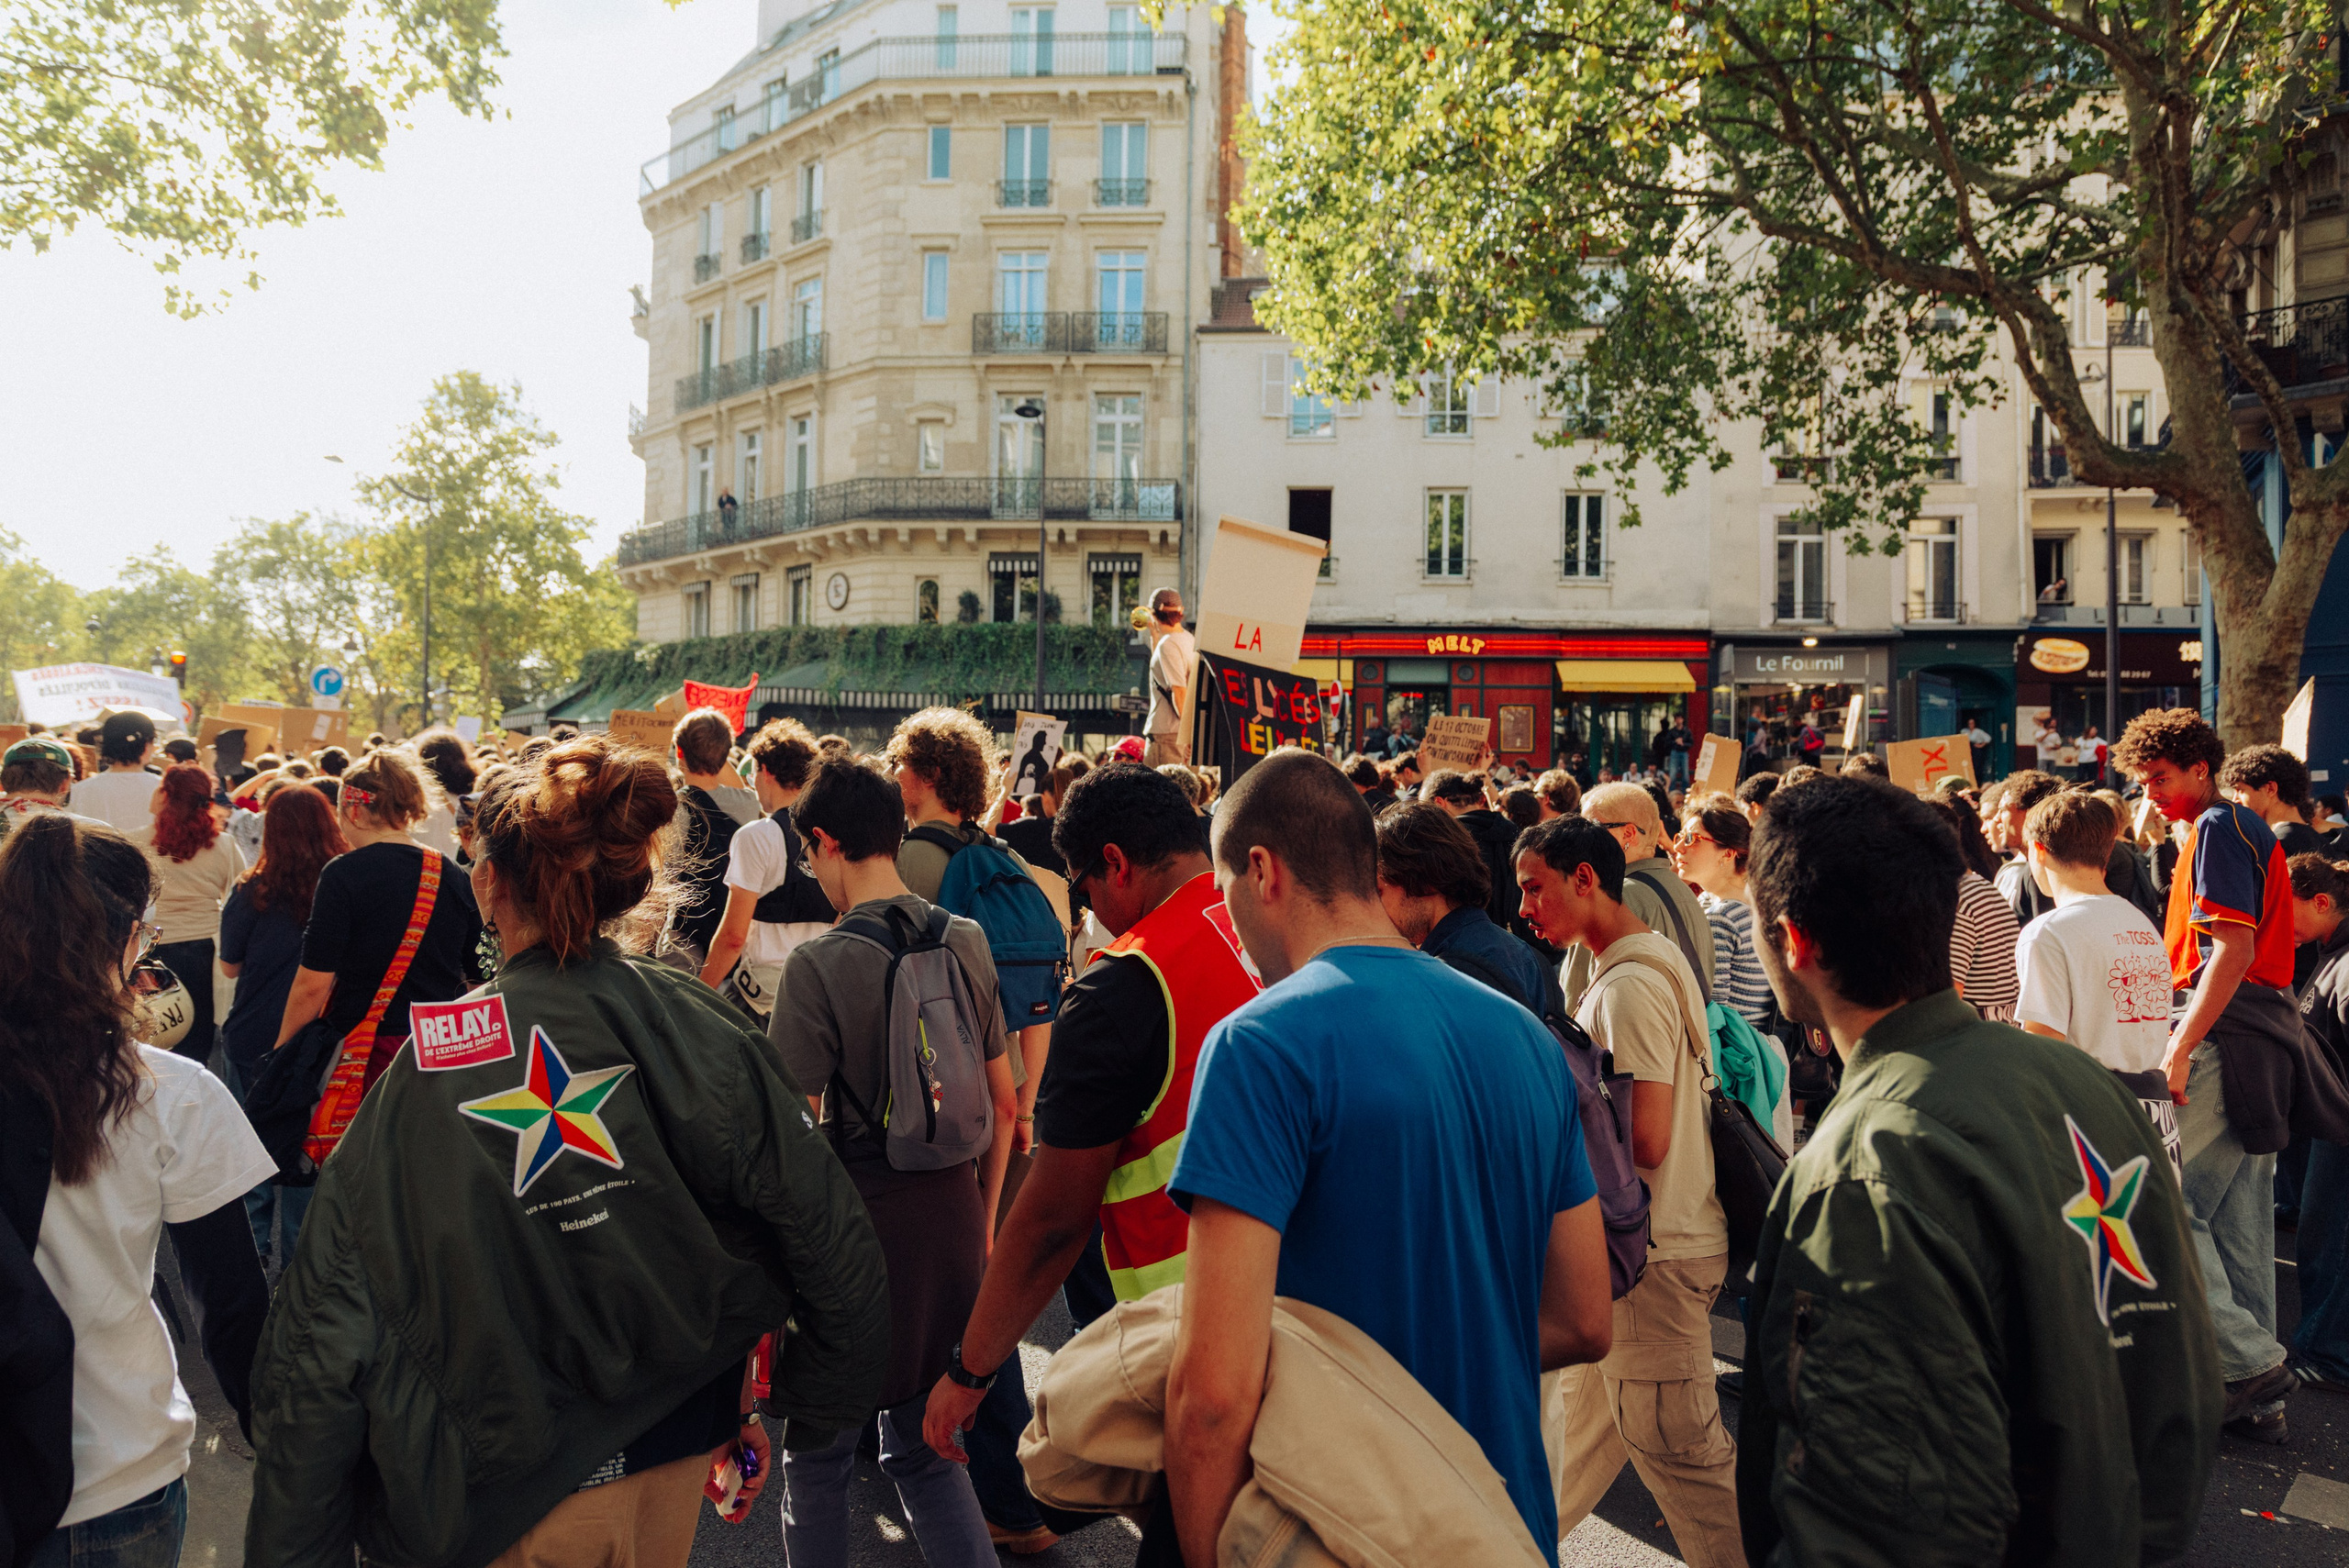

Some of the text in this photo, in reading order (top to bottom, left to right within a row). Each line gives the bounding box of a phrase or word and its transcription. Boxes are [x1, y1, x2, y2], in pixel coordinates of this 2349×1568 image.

[1234, 623, 1262, 652] LA
[1427, 635, 1486, 655] MELT
[1756, 654, 1844, 672] Le Fournil
[1433, 720, 1484, 735] LE 17 OCTOBRE
[1426, 733, 1438, 744] ON
[1439, 734, 1461, 746] QUITTE
[425, 1031, 502, 1057] DE L'EXTRÊME DROITE
[957, 1024, 971, 1044] ALVA
[551, 1200, 562, 1208] 190
[607, 1180, 629, 1190] ÉTOILE
